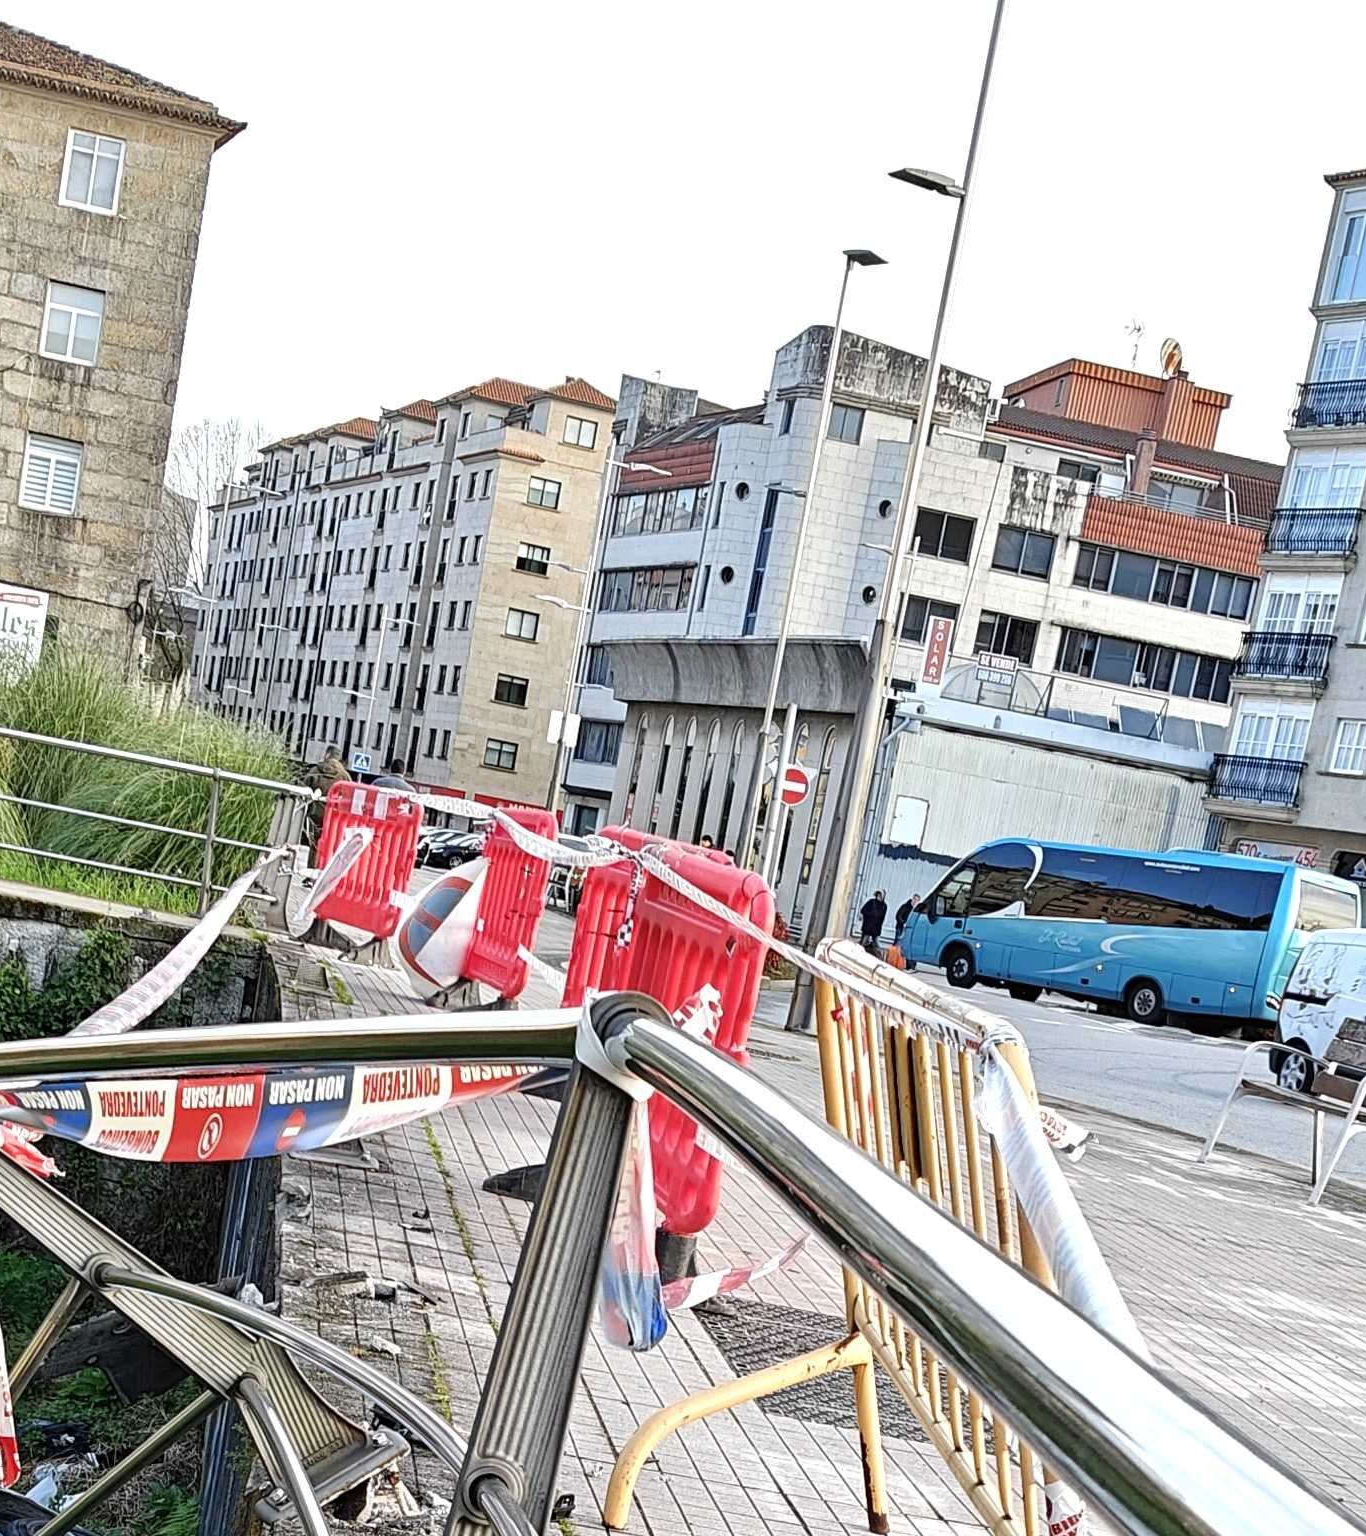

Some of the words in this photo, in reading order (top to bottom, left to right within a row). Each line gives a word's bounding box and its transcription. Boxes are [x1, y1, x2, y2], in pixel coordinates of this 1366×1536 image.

[929, 620, 945, 675] SOLAR
[181, 1085, 226, 1109] PASAR
[227, 1082, 255, 1107] NON
[268, 1077, 314, 1106] PASAR
[315, 1074, 346, 1101] NON
[362, 1066, 441, 1105] PONTEVEDRA
[58, 1089, 86, 1111] NON
[99, 1089, 168, 1118] PONTEVEDRA
